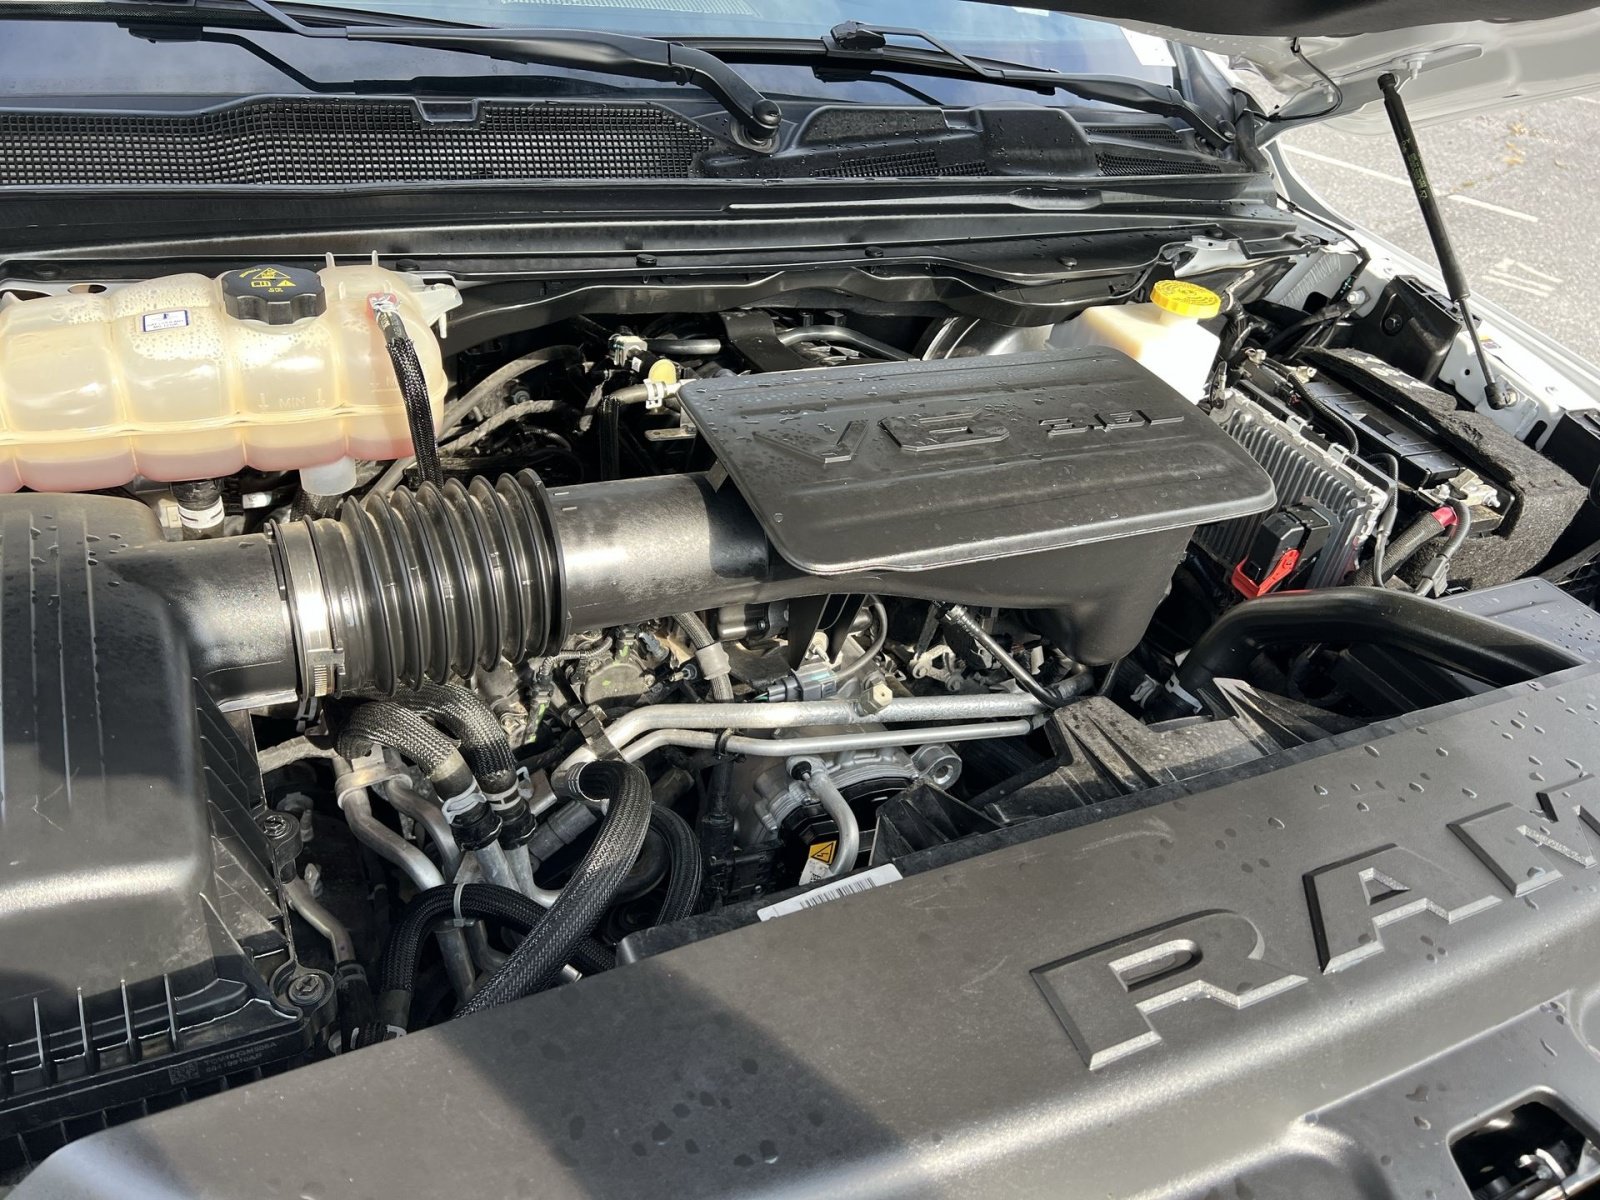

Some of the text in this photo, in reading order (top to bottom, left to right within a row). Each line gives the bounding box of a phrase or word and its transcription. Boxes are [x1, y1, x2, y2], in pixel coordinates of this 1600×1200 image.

[279, 397, 306, 409] MIN
[752, 408, 1010, 465] V6
[1029, 774, 1600, 1071] RAM
